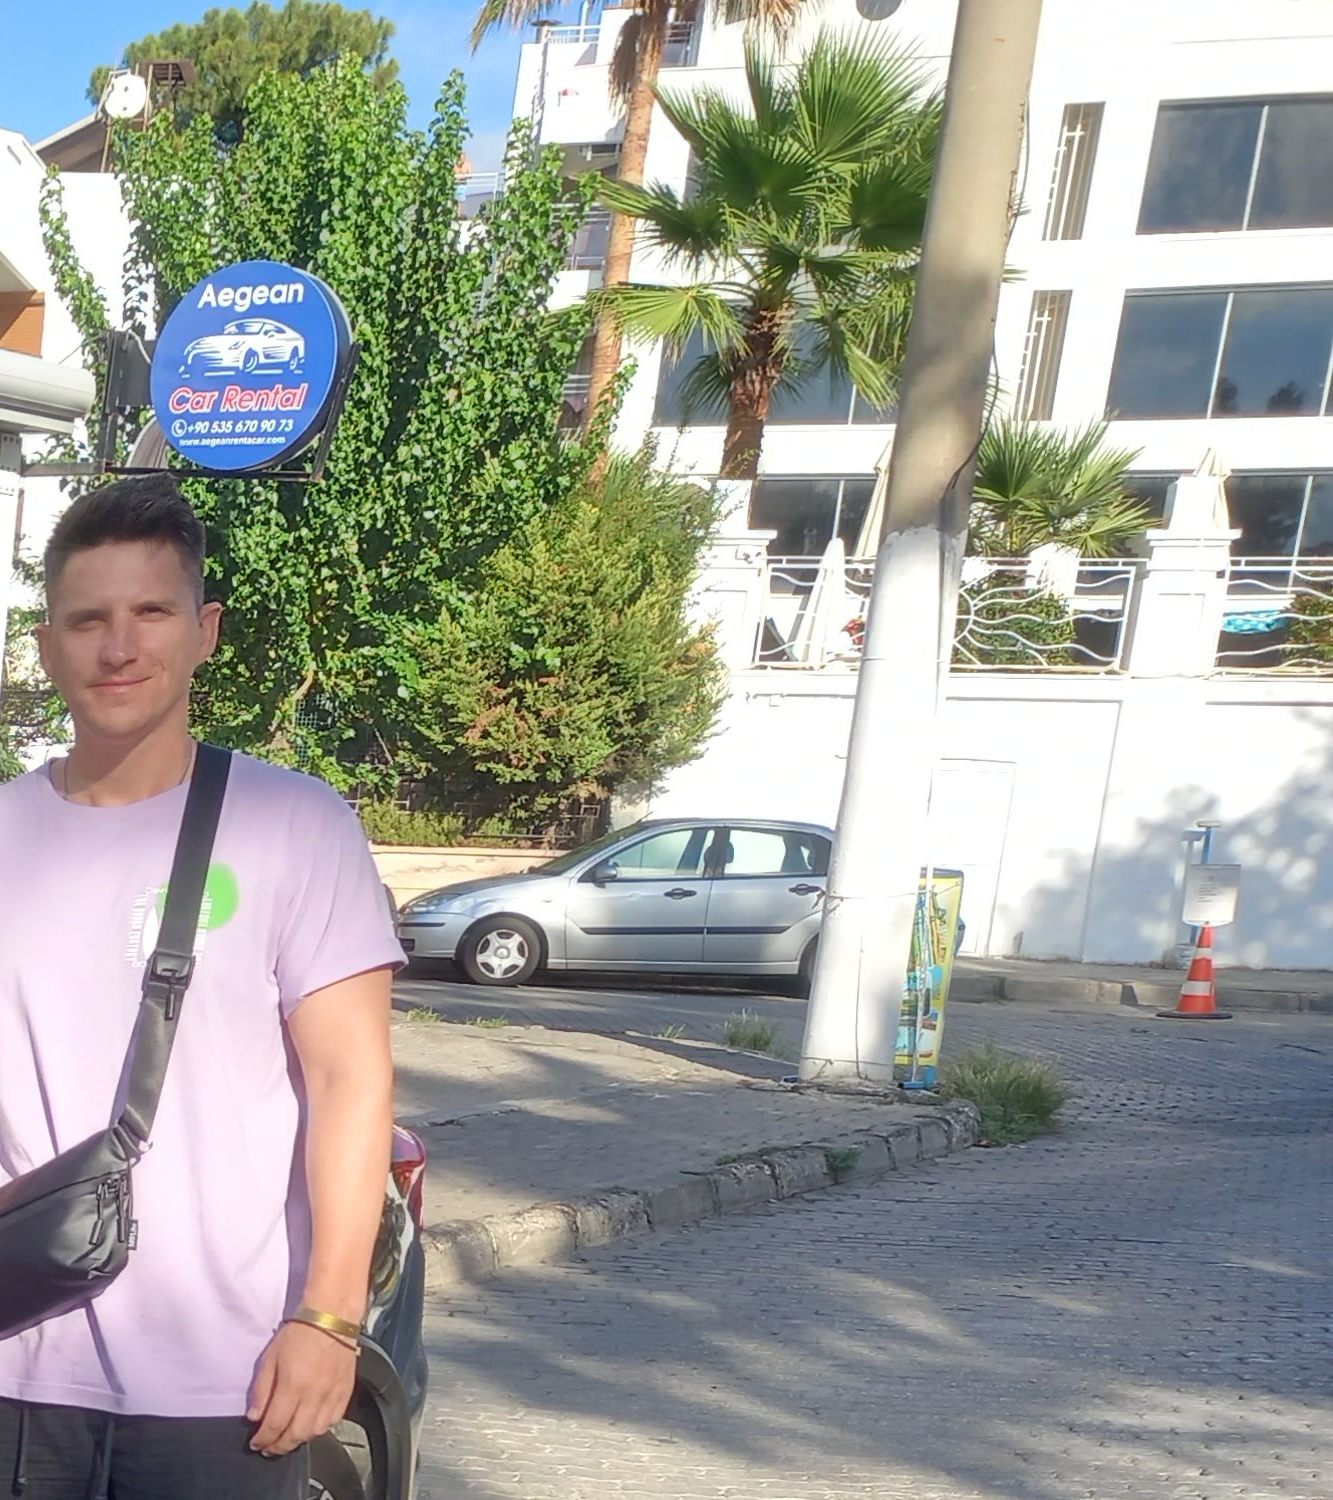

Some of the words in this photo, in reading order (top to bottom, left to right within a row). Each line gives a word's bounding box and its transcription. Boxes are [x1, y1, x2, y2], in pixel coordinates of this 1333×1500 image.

[197, 282, 304, 312] Aegean
[169, 387, 218, 414] Car
[220, 382, 309, 412] Rental
[187, 421, 209, 434] +90
[211, 420, 233, 433] 535
[235, 419, 257, 433] 670
[260, 419, 275, 432] 90
[278, 418, 293, 432] 73
[179, 435, 286, 447] www.aegeanrentacar.com
